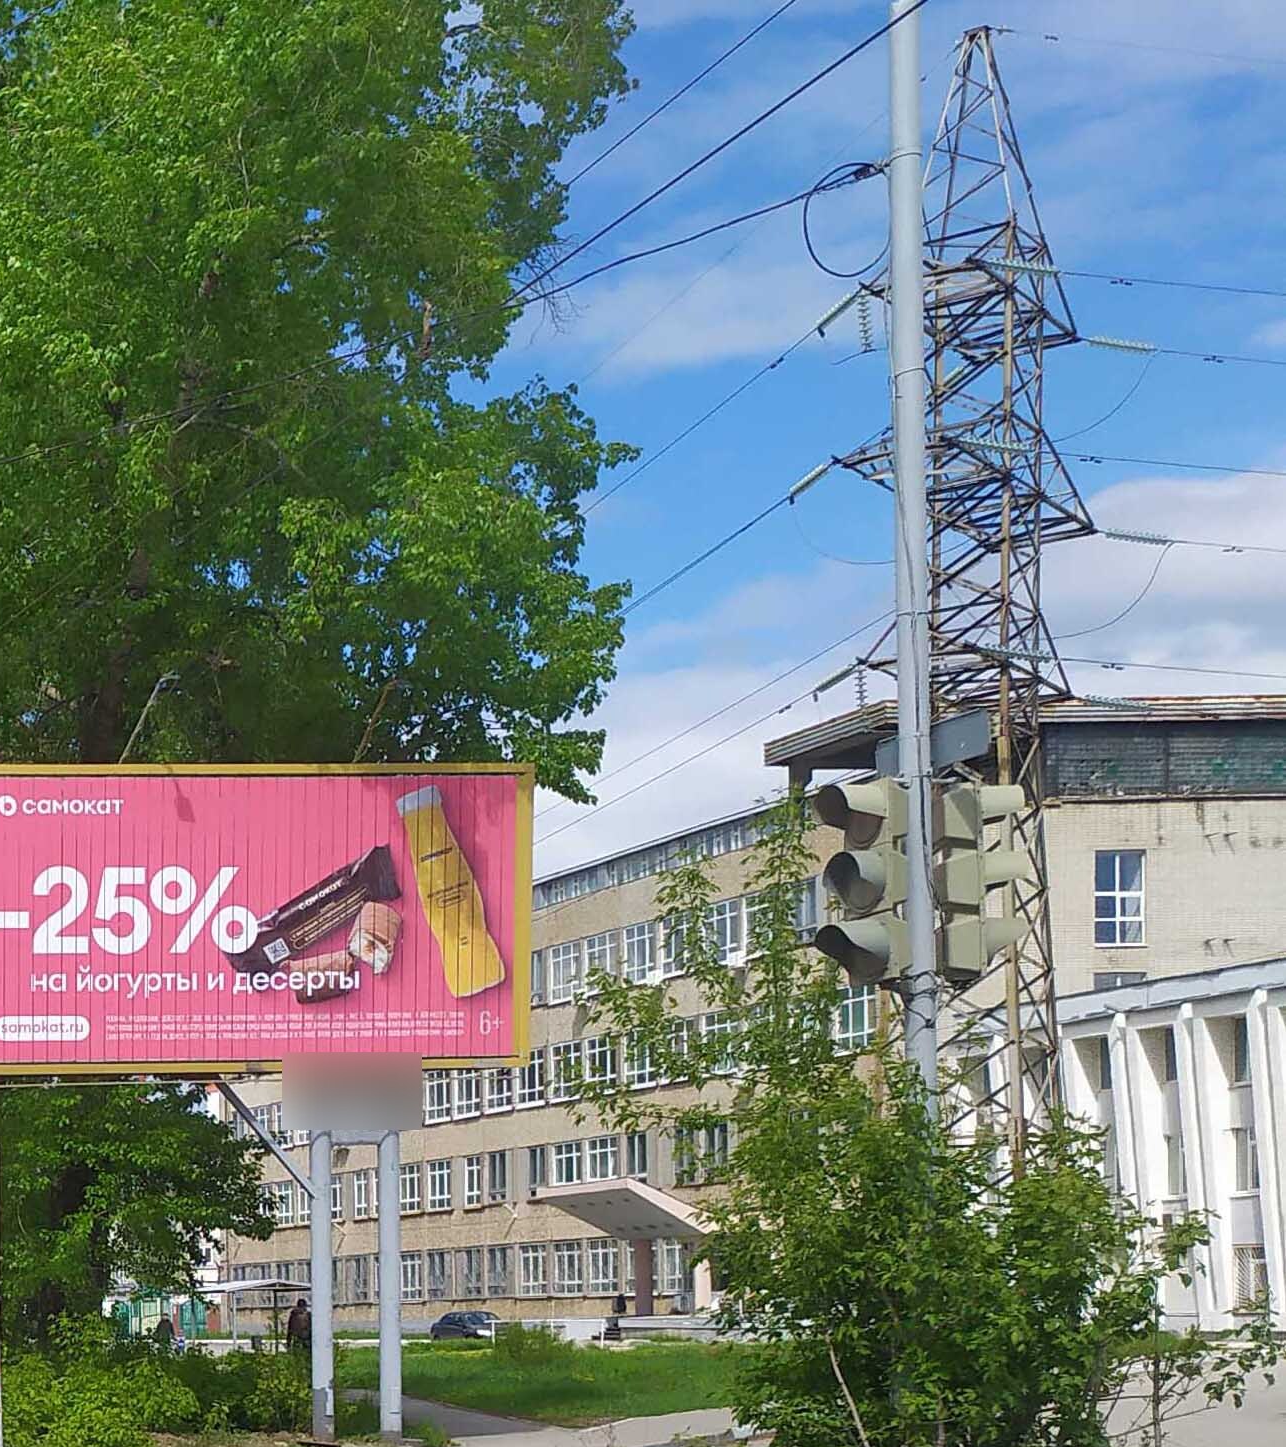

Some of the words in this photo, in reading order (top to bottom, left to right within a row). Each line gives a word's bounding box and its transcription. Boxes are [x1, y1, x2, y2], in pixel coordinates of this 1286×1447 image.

[22, 798, 124, 816] самокат
[31, 972, 68, 993] на
[77, 965, 198, 999] йогурты
[207, 972, 225, 992] и
[232, 970, 360, 999] десерты
[0, 1018, 85, 1035] samokat.ru
[479, 1010, 505, 1035] 6+
